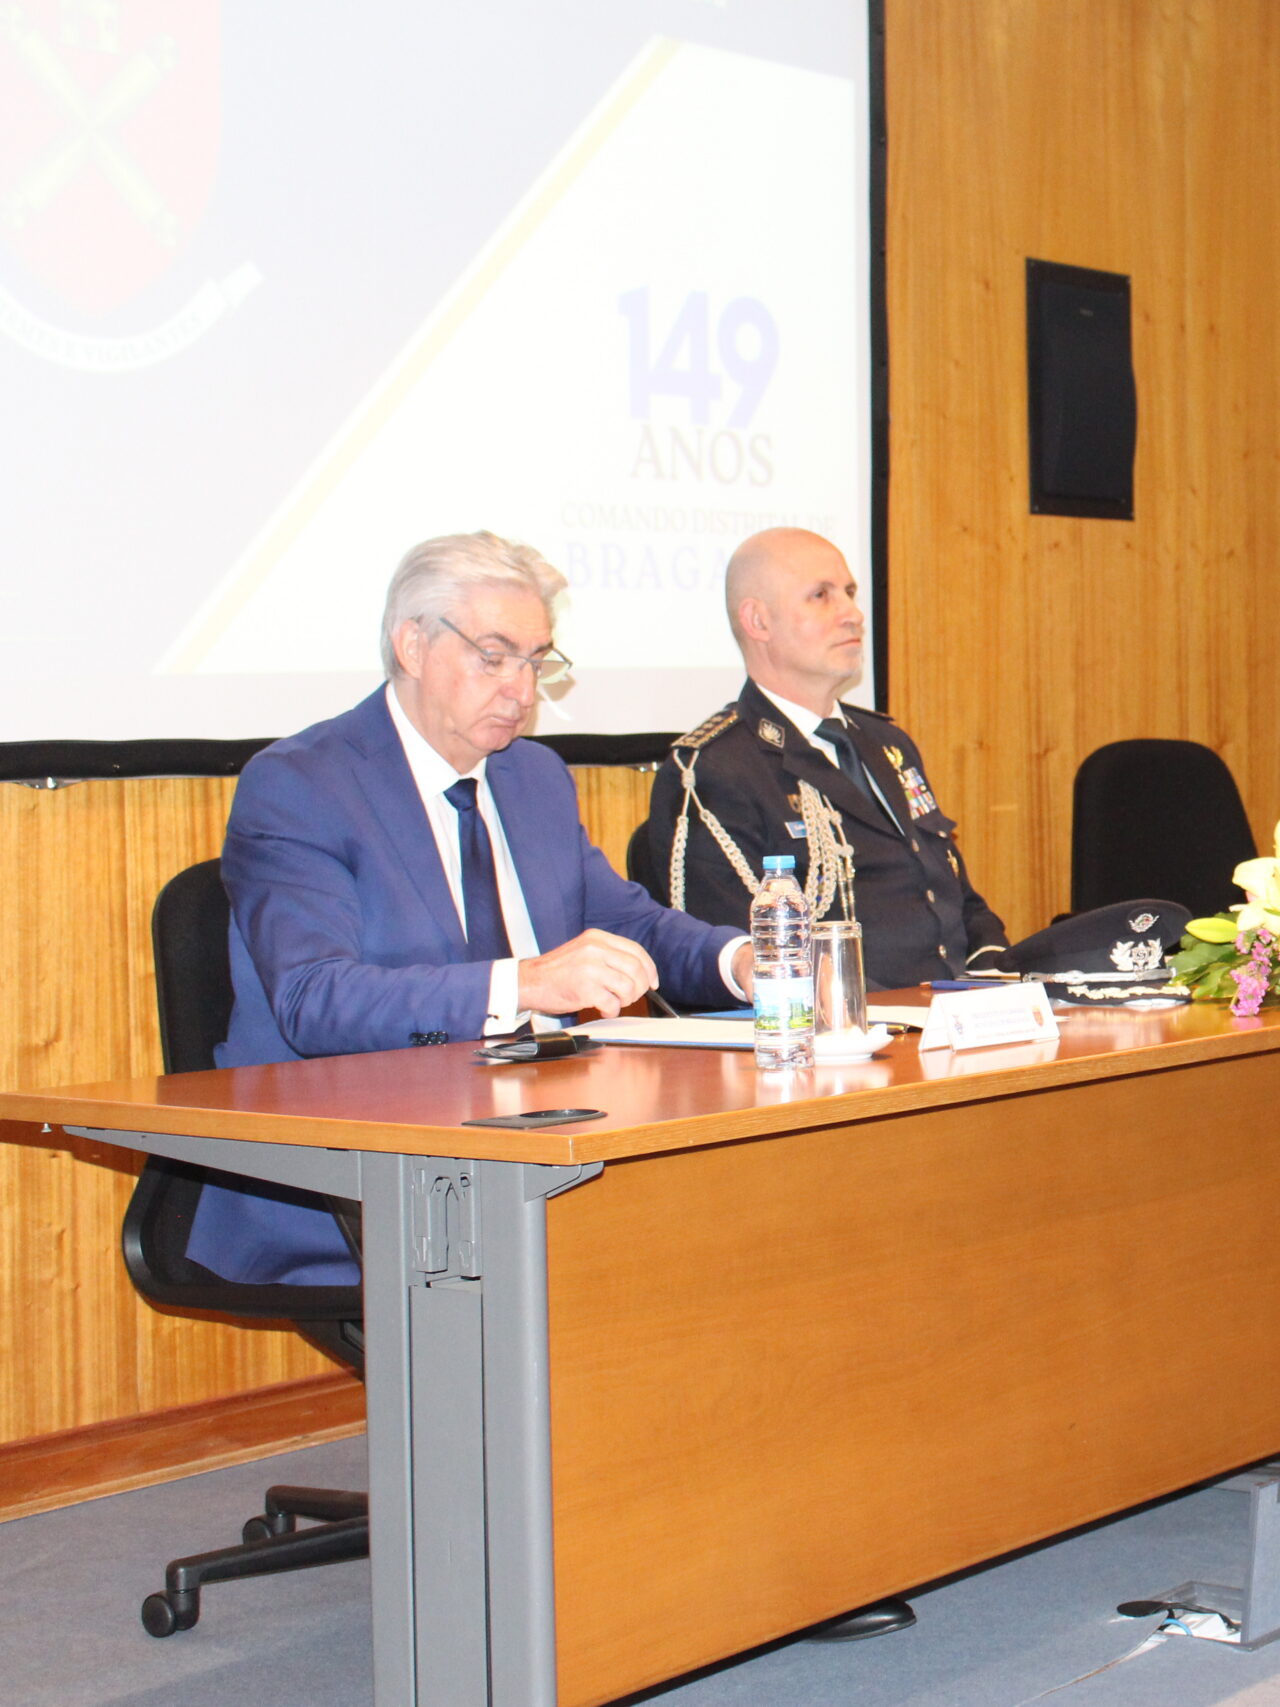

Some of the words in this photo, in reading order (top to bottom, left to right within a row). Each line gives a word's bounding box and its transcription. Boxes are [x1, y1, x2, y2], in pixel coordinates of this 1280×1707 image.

[617, 286, 779, 428] 149
[630, 424, 775, 488] ANOS
[560, 500, 687, 534] COMANDO
[566, 540, 726, 593] BRAGA
